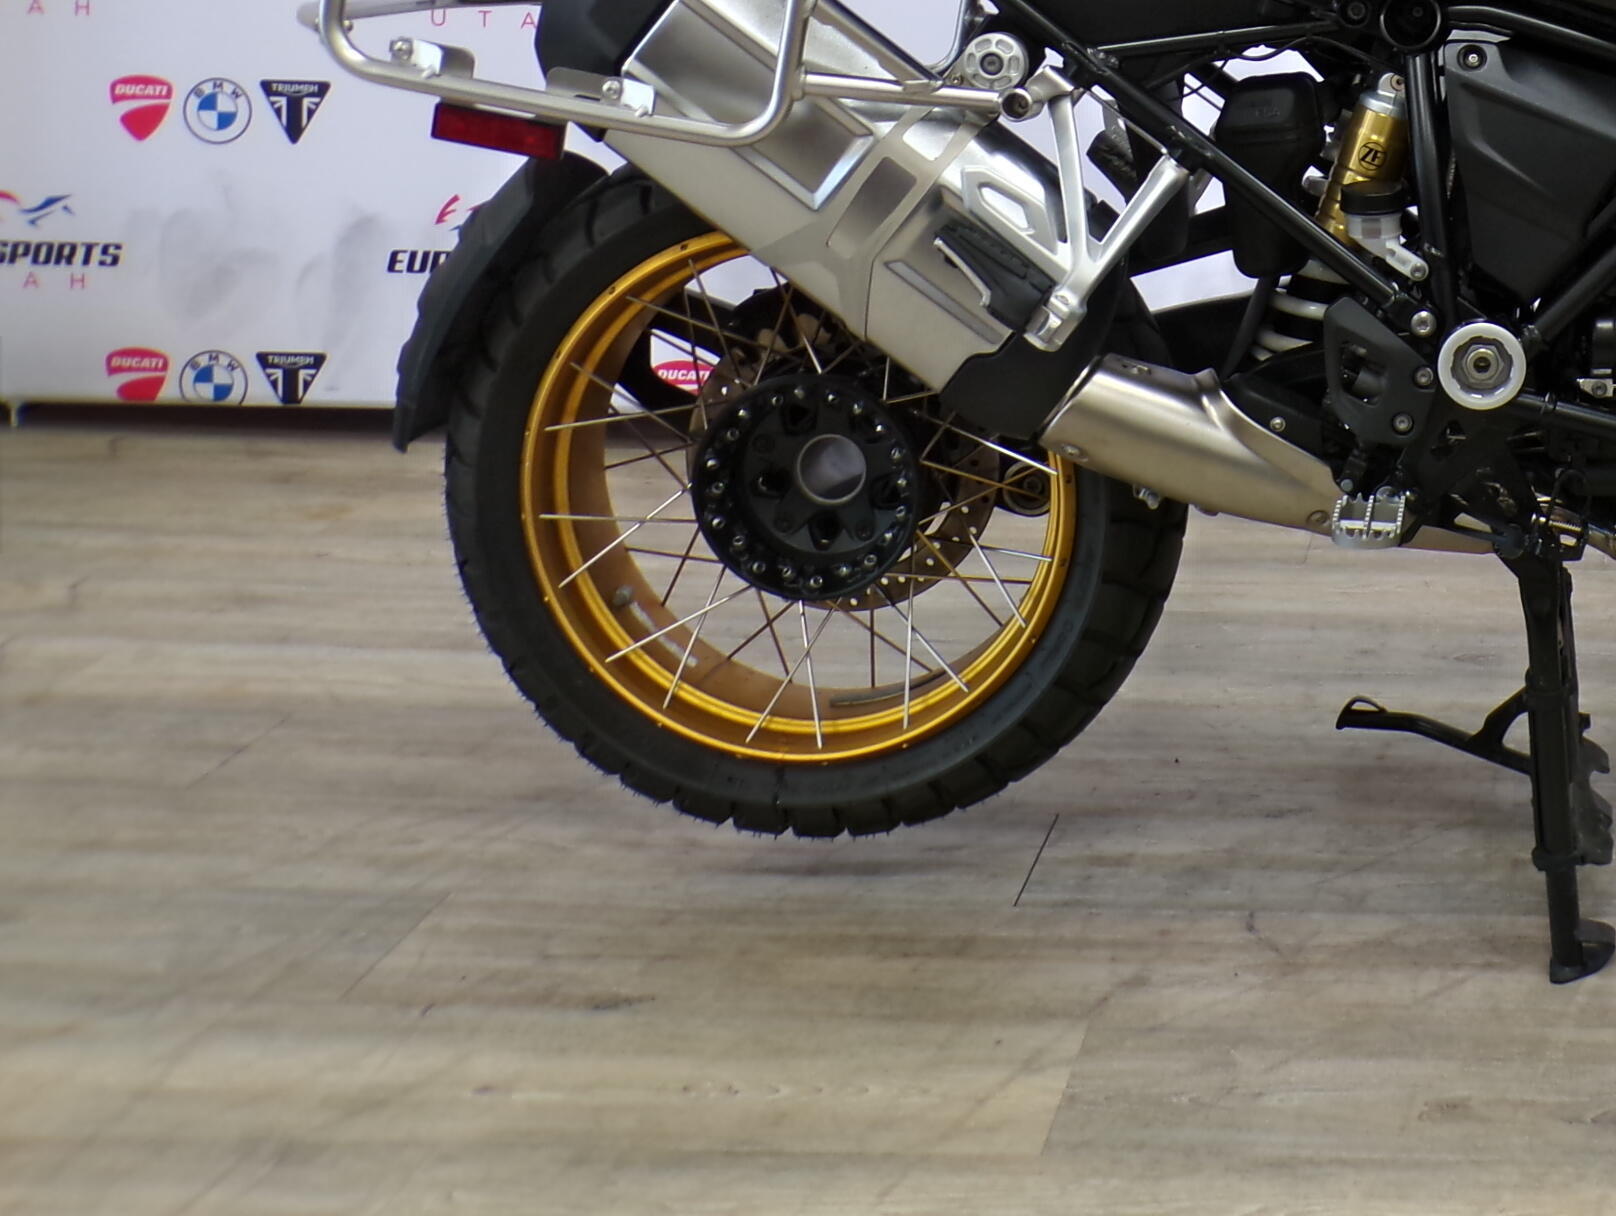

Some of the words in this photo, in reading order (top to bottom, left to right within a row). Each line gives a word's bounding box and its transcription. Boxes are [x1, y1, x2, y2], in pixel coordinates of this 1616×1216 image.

[431, 7, 541, 30] UTA
[114, 83, 169, 98] DUCATI
[270, 82, 320, 95] TRIUMPH
[1359, 145, 1386, 166] ZF
[109, 355, 167, 370] DUCATI
[266, 354, 317, 367] TRIUMPH
